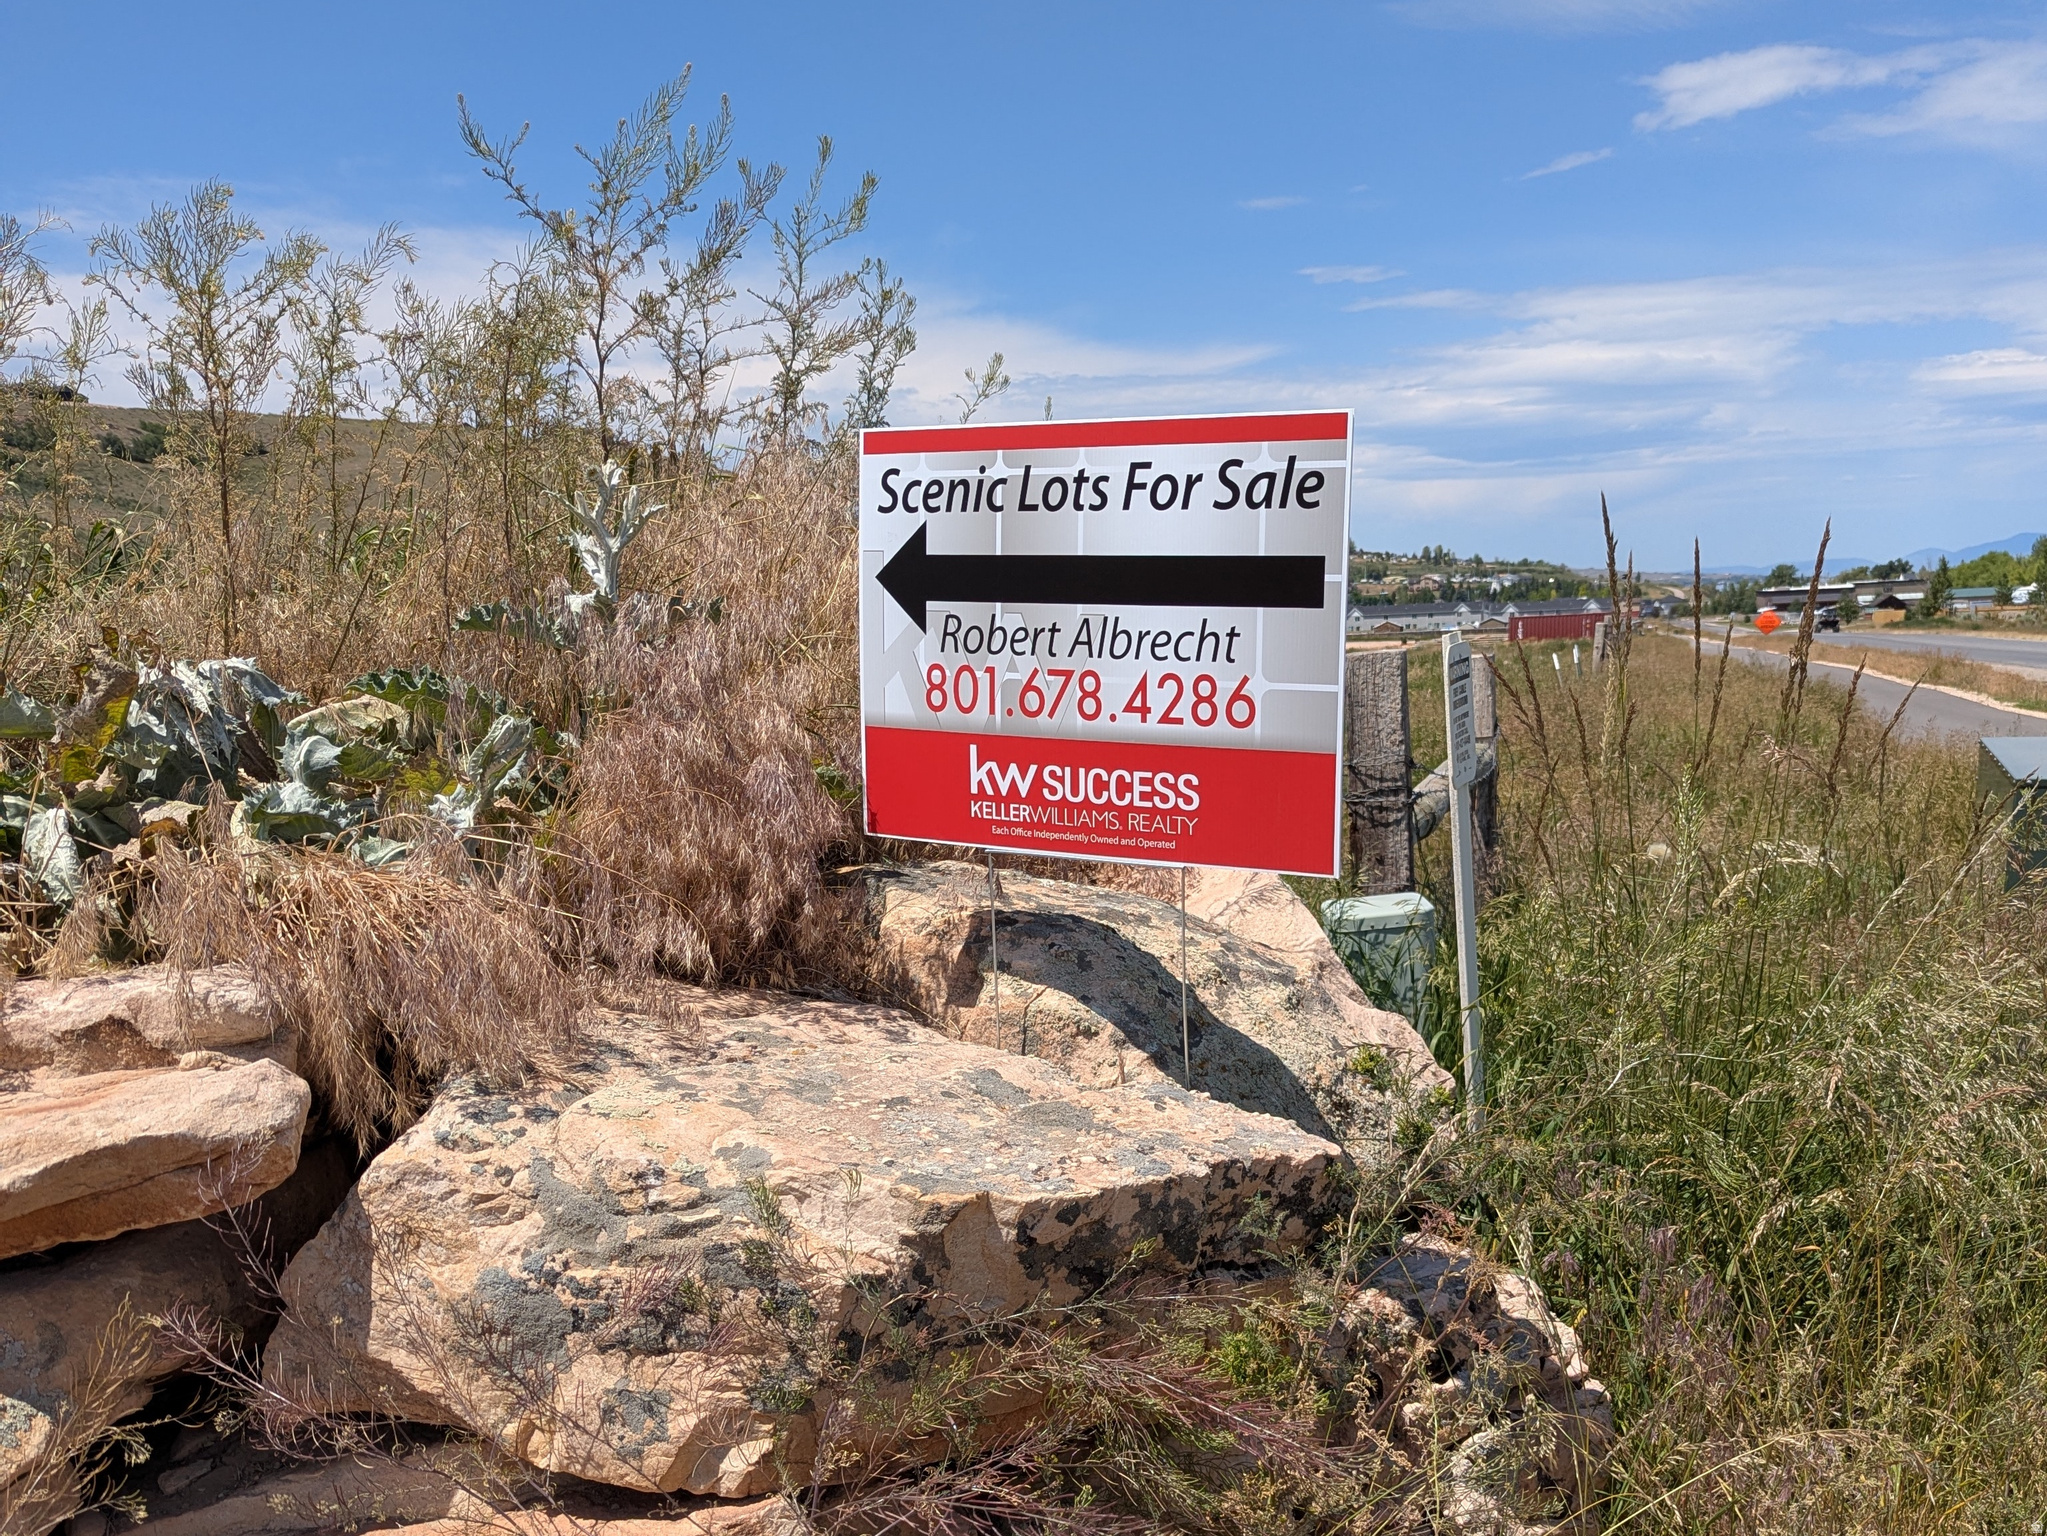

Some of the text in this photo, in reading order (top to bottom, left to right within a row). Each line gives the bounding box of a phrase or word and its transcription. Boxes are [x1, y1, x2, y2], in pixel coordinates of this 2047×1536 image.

[877, 455, 1325, 513] Scenic Lots For Sale
[940, 614, 1241, 663] Robert Albrecht
[925, 663, 1257, 729] 801.678.4286
[969, 744, 1200, 810] kw SUCCESS
[991, 826, 1176, 849] Each Office Independently Owned and Operated
[1128, 813, 1199, 836] REALTY
